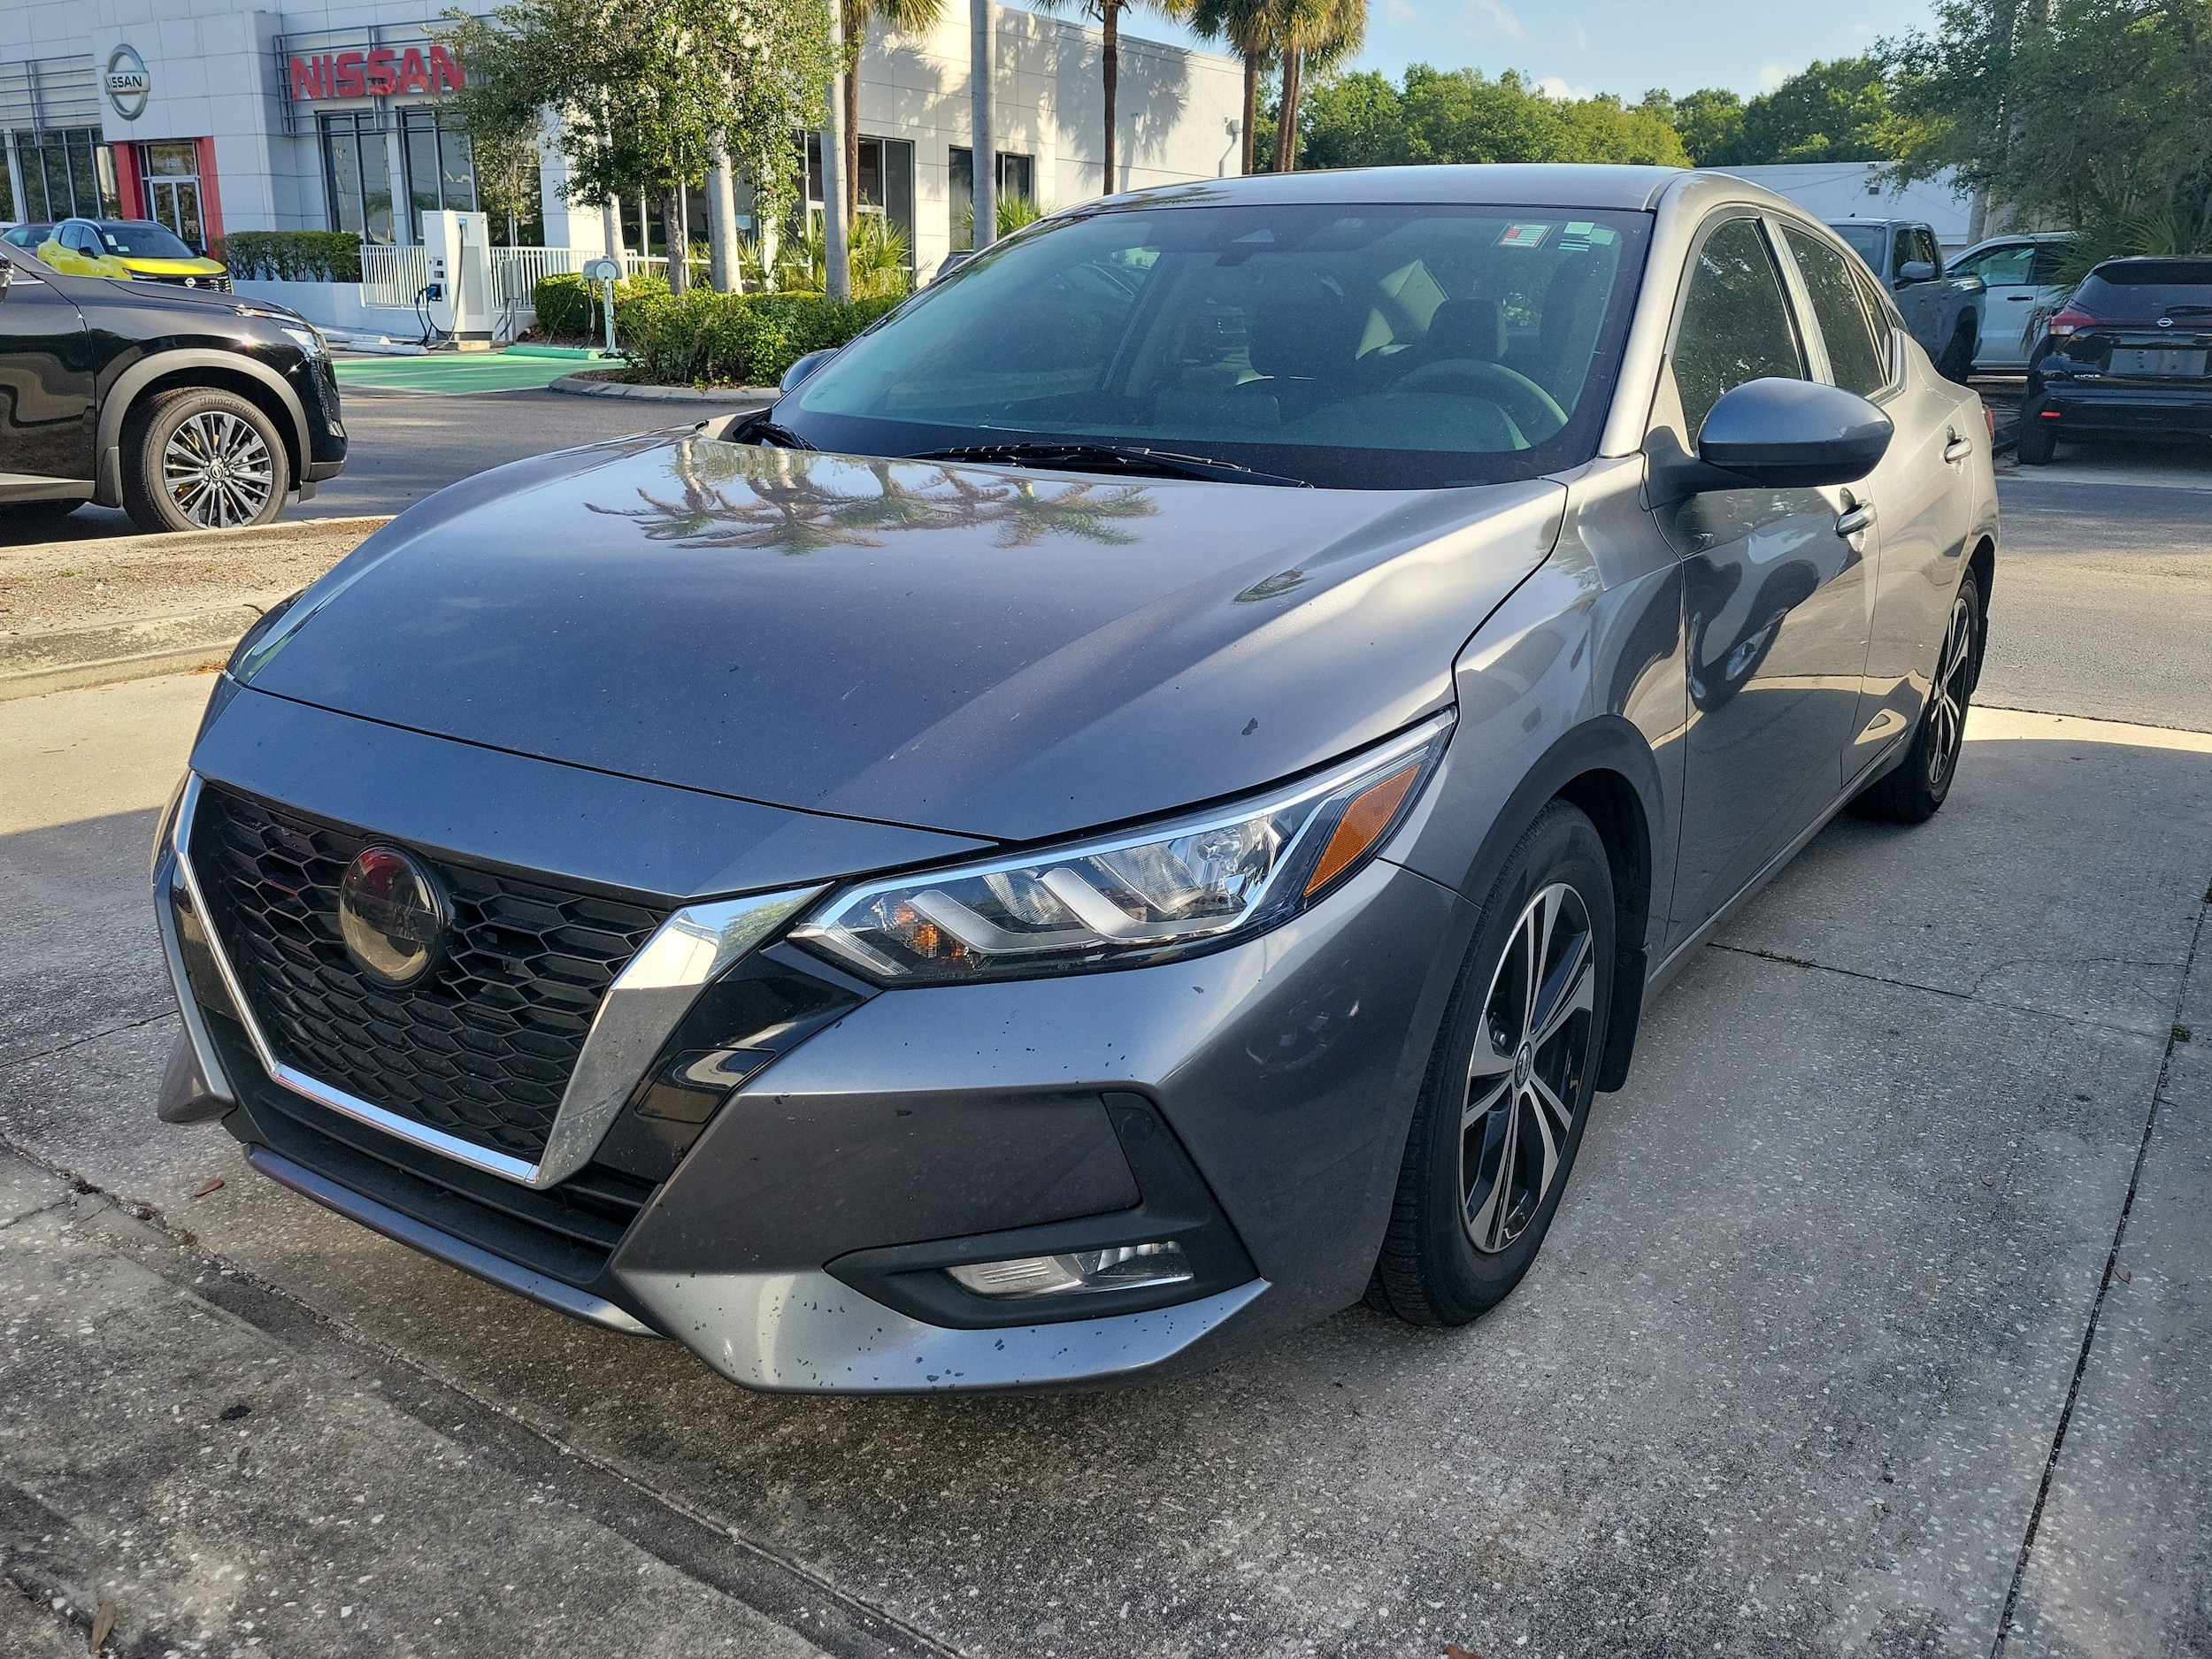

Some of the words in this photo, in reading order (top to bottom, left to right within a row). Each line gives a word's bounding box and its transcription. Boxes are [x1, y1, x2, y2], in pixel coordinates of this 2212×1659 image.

[105, 75, 142, 88] NISSAN
[290, 46, 465, 100] NISSAN
[199, 397, 260, 421] BRIDGESTONE
